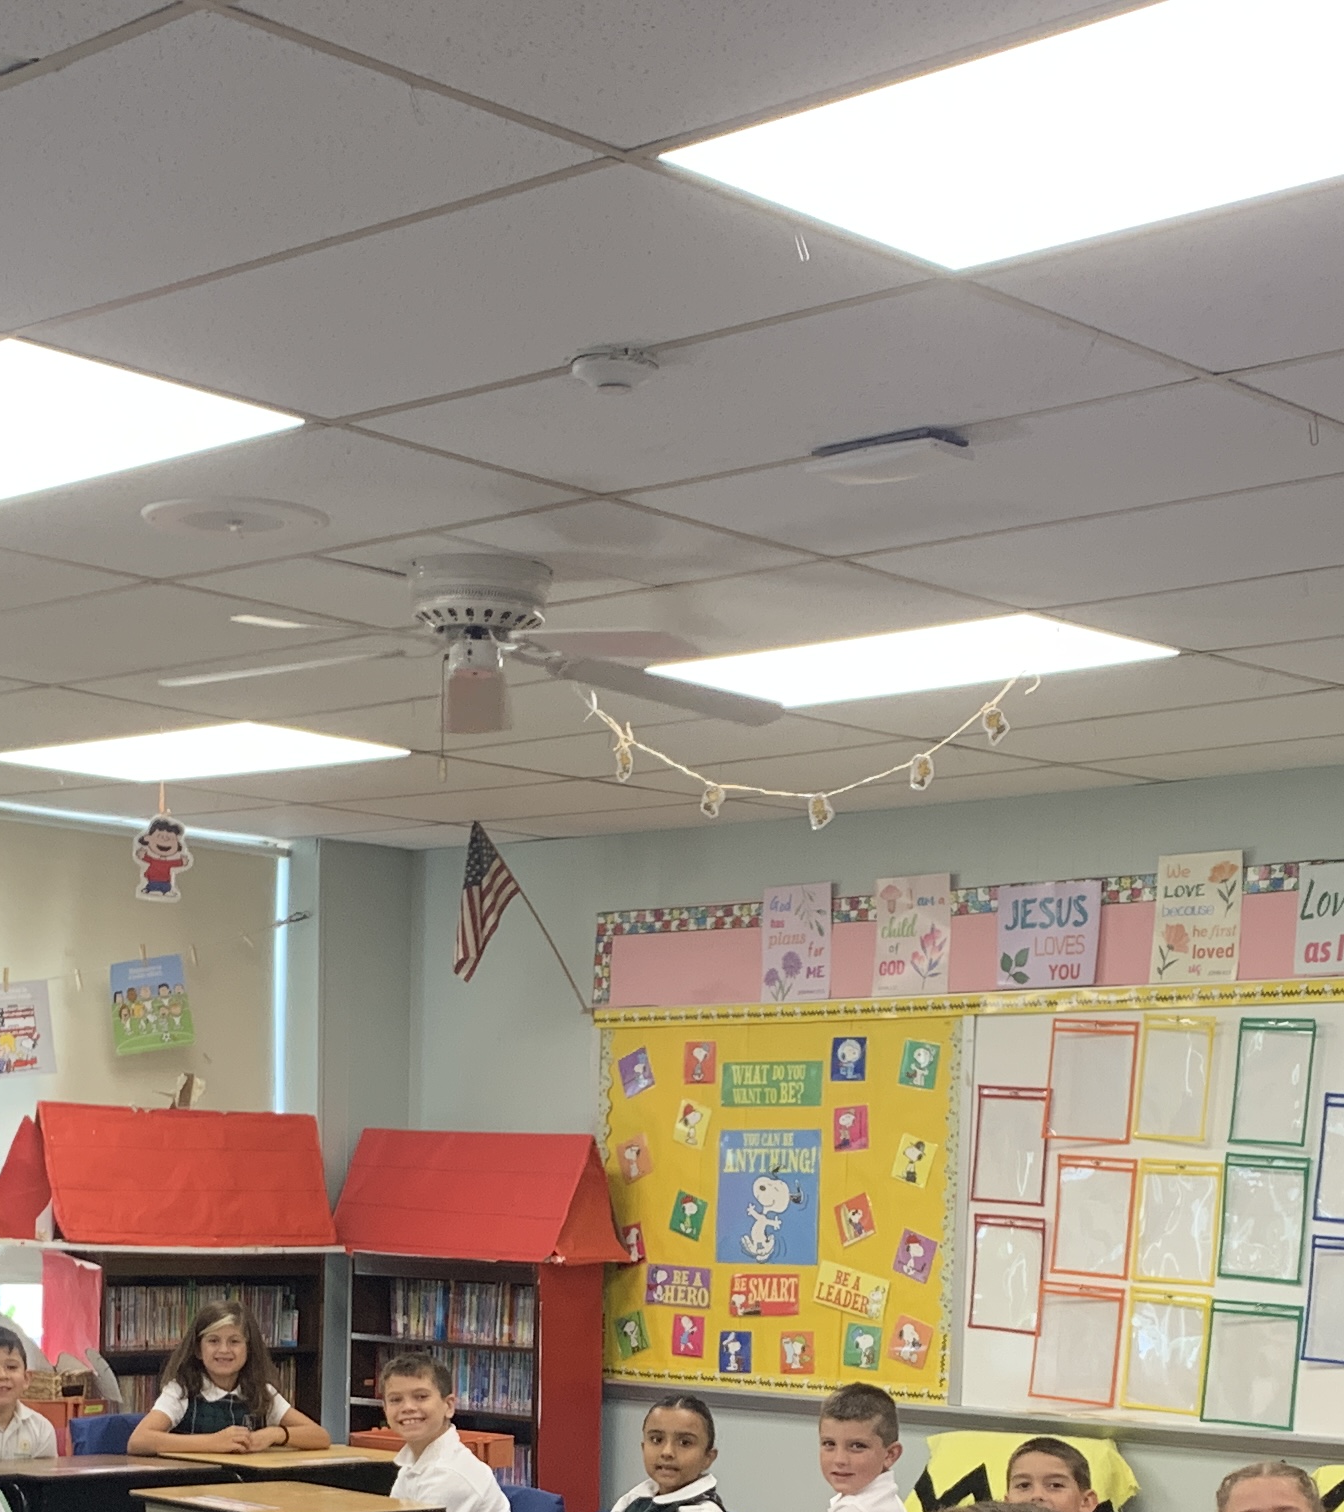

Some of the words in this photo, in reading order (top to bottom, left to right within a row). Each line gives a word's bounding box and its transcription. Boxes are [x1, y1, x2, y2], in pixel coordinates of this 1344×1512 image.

[1166, 863, 1191, 879] We
[1163, 883, 1205, 899] LOVE
[1004, 894, 1089, 931] JESUS
[1161, 903, 1214, 917] because
[881, 913, 918, 939] child
[1192, 925, 1208, 938] he
[1208, 923, 1237, 940] first
[768, 932, 806, 949] plans
[889, 942, 900, 955] of
[1034, 934, 1086, 957] LOVES
[1191, 943, 1235, 959] loved
[1304, 941, 1331, 963] as
[806, 965, 825, 979] ME
[879, 960, 905, 976] GOD
[1048, 963, 1080, 981] YOU
[731, 1065, 770, 1085] WHAT
[772, 1065, 785, 1080] DO
[786, 1065, 807, 1080] YOU
[733, 1088, 762, 1104] WANT
[764, 1088, 777, 1104] TO
[779, 1082, 805, 1104] BE?
[743, 1133, 760, 1146] YOU
[761, 1133, 781, 1146] CAN
[782, 1133, 794, 1146] BE
[724, 1146, 816, 1173] ANYTHING!
[672, 1270, 689, 1285] BE
[693, 1271, 703, 1286] A
[834, 1269, 850, 1285] BE
[851, 1277, 861, 1291] A
[662, 1285, 709, 1307] HERO
[732, 1277, 747, 1292] BE
[748, 1277, 799, 1304] SMART
[816, 1282, 870, 1314] LEADER
